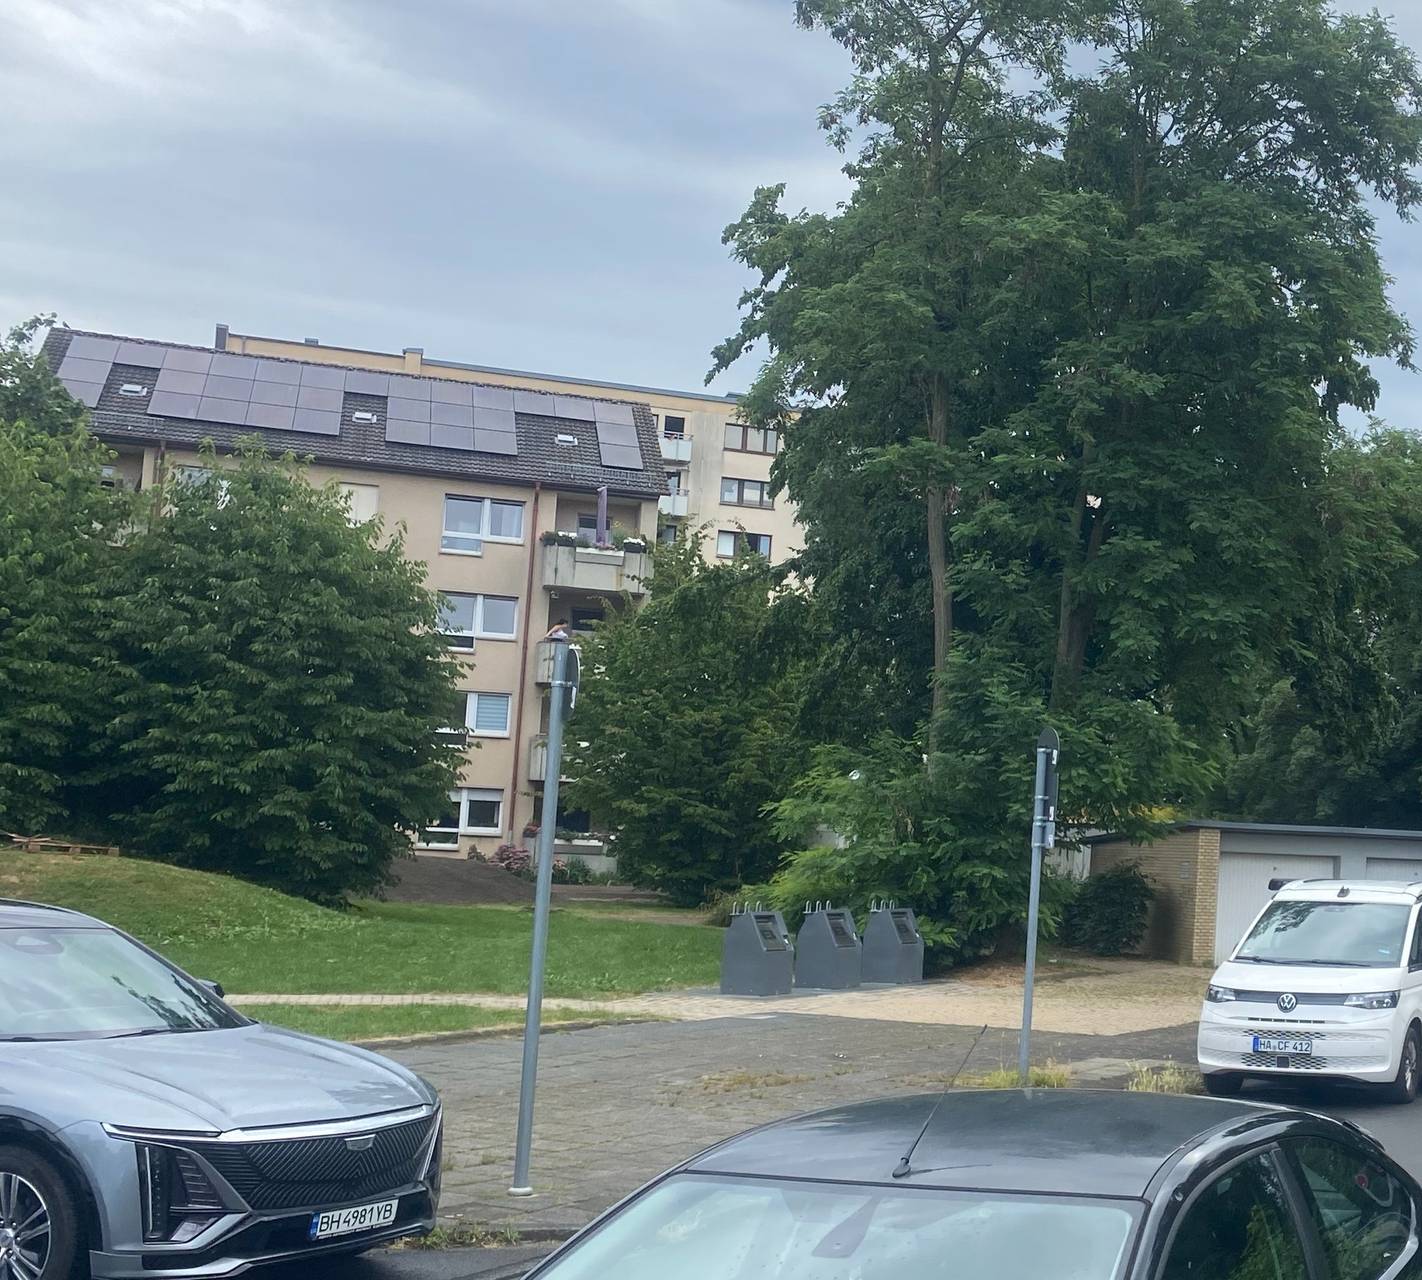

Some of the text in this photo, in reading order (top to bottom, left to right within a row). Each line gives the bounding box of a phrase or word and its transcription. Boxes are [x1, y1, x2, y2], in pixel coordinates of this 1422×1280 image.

[1259, 1040, 1311, 1052] HA CF 412
